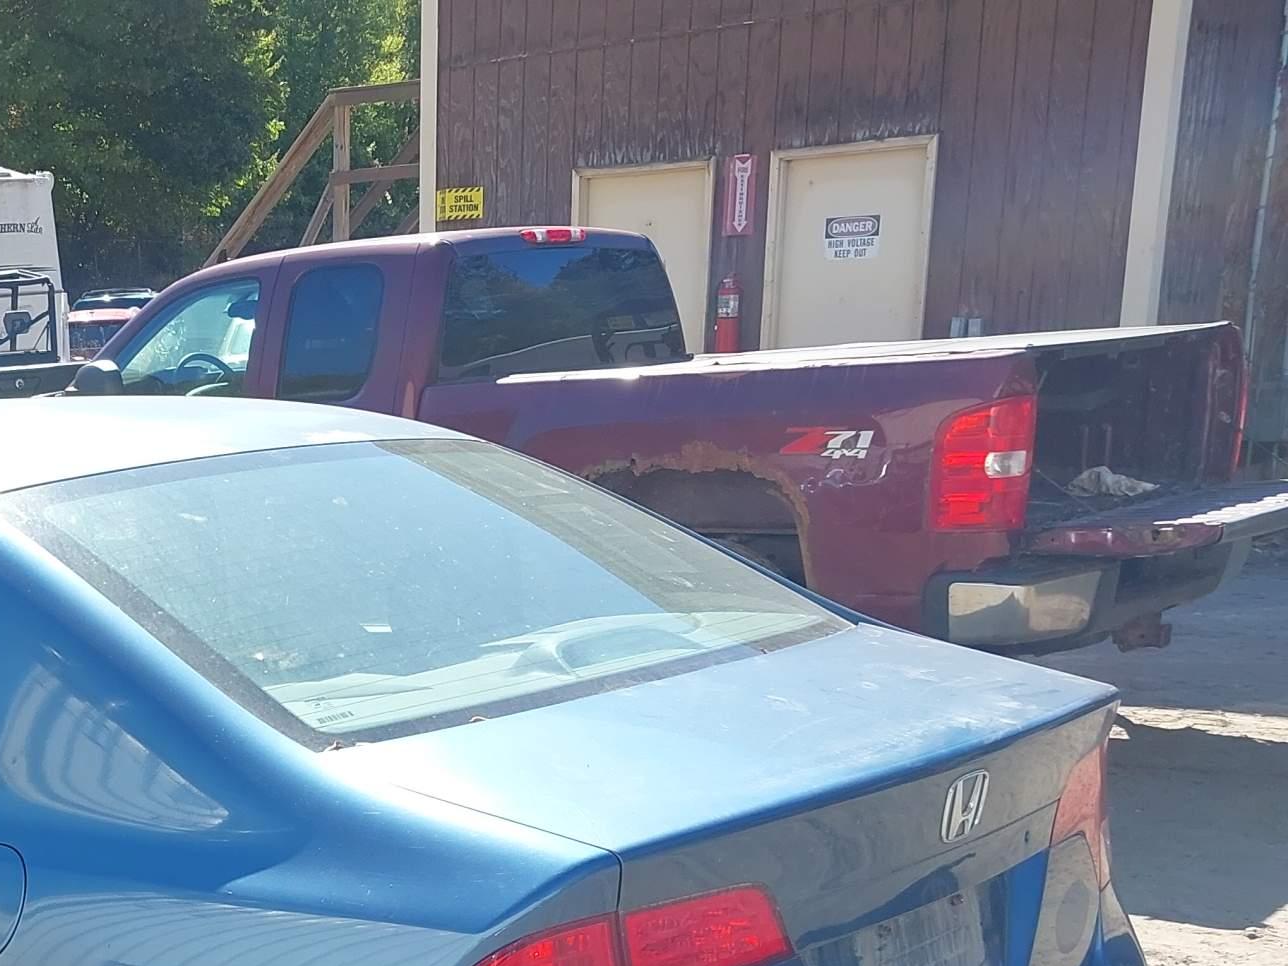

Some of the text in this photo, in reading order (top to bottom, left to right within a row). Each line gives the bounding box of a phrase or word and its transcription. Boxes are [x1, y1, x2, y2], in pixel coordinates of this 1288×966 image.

[454, 194, 474, 203] SPILL
[448, 204, 479, 213] STATION
[832, 220, 873, 234] DANGER
[827, 237, 874, 249] HIGH VOLTAGE
[834, 248, 867, 258] KEEP OUT
[779, 426, 874, 455] Z71
